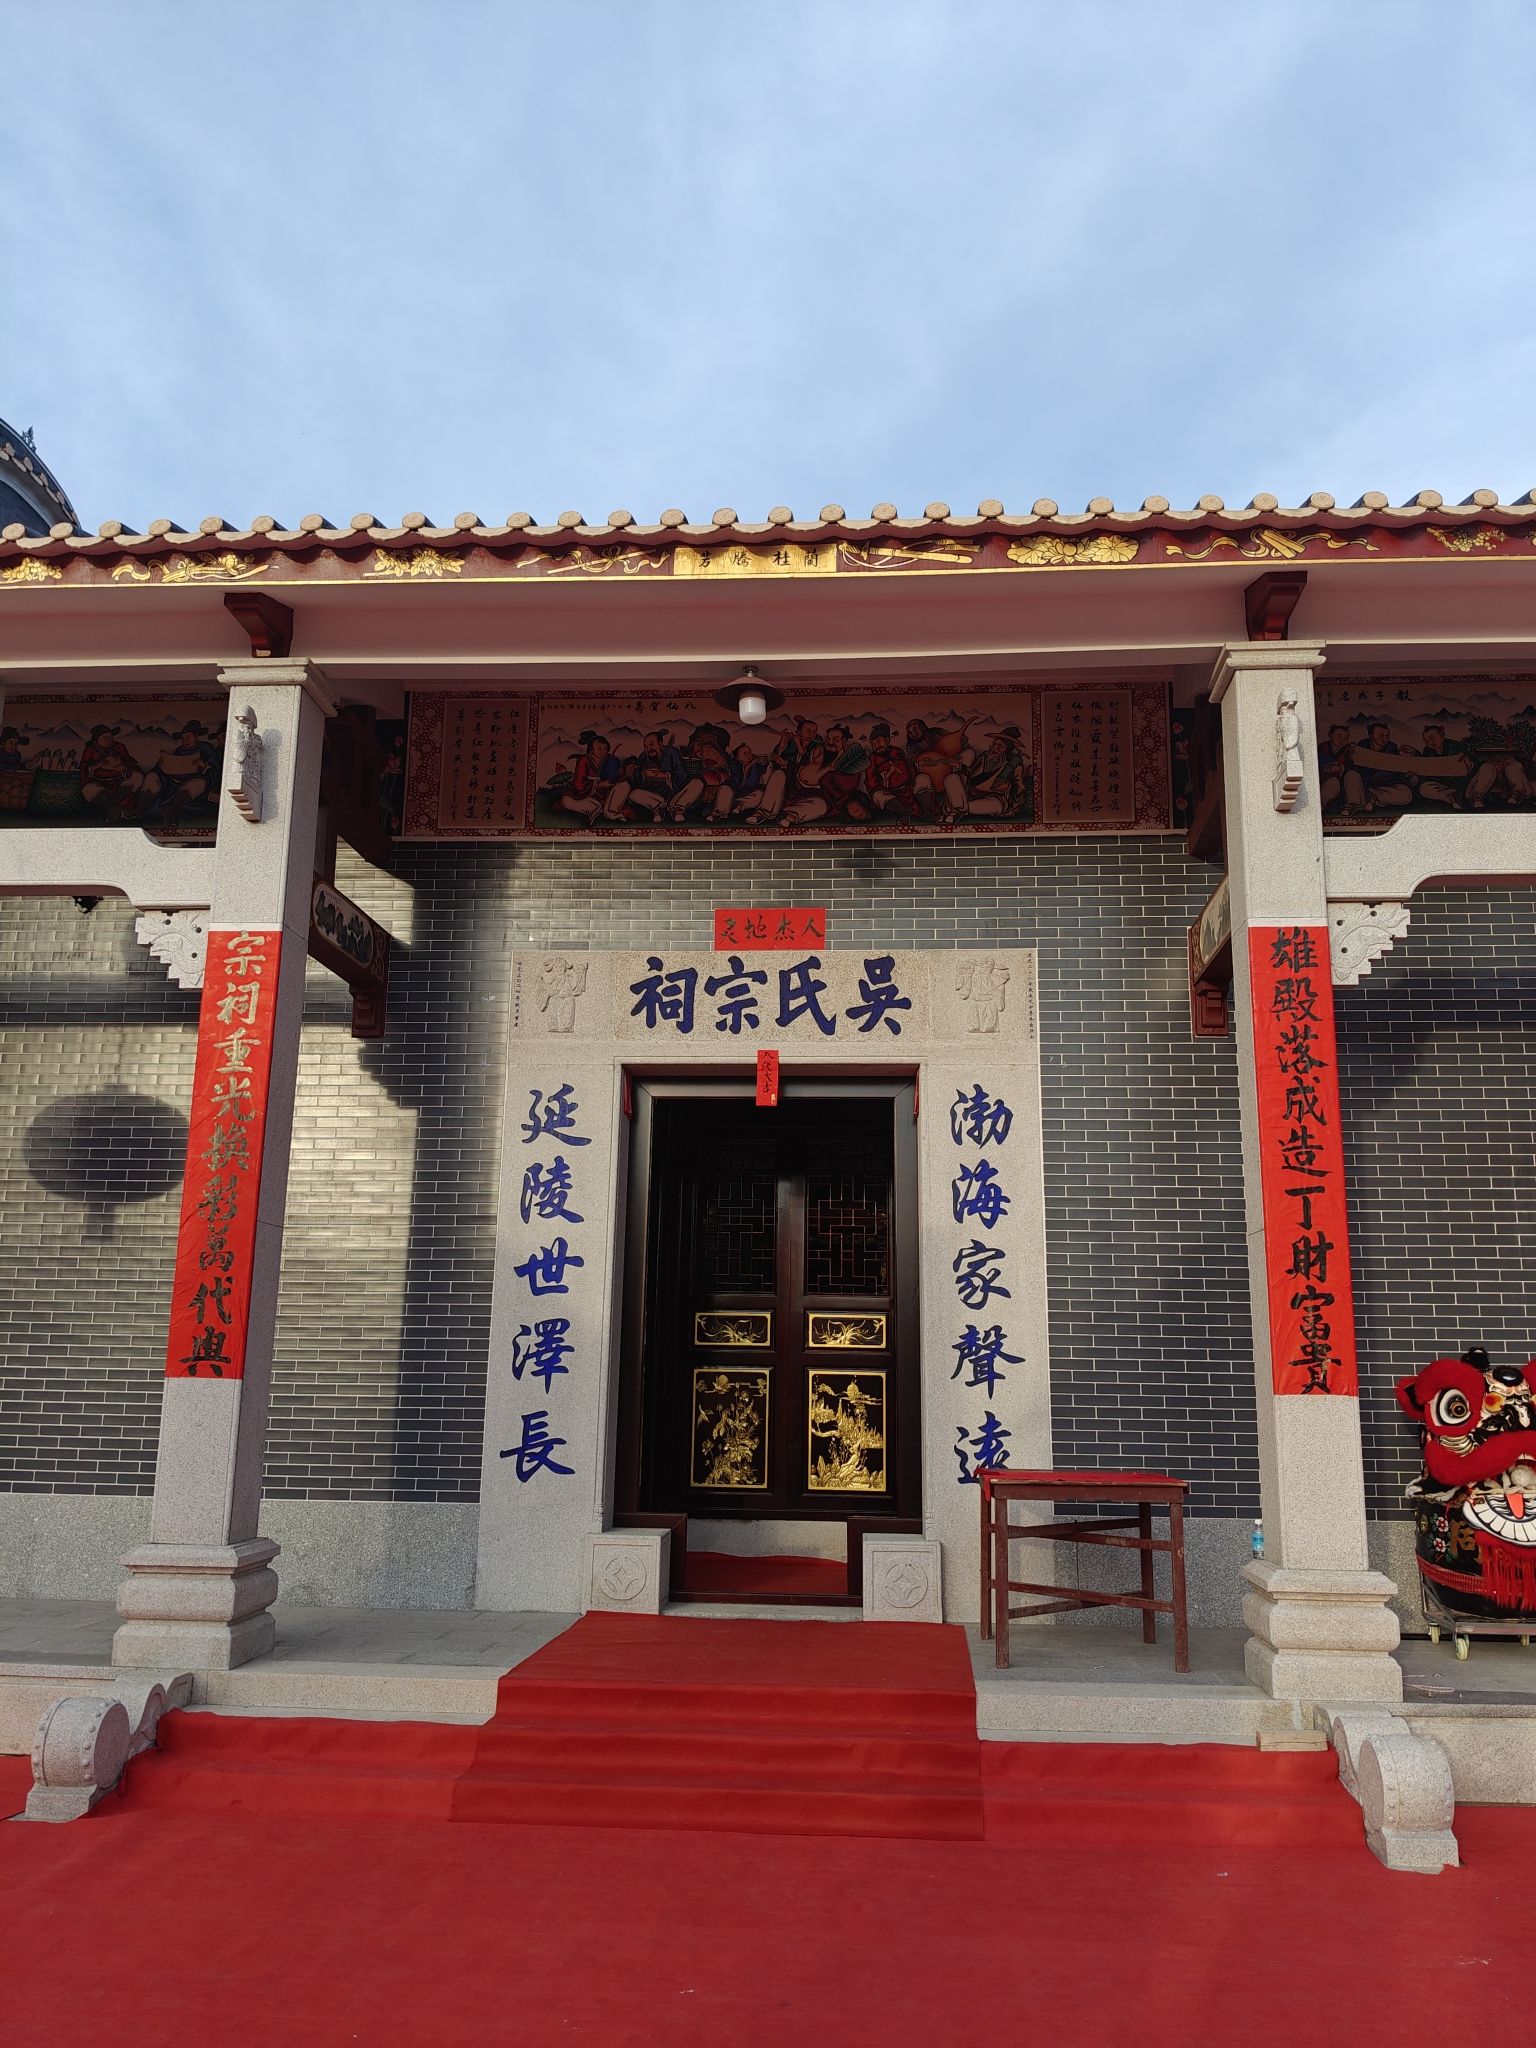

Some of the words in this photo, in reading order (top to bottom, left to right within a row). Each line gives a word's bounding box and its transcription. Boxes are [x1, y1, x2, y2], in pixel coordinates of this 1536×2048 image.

[698, 548, 819, 568] 蘭桂騰芳
[631, 956, 913, 1037] 吳氏宗祠
[719, 913, 824, 945] 人杰地灵
[1267, 926, 1343, 1395] 雄殿落成造丁財富貴
[500, 1083, 592, 1483] 延陵世澤長
[951, 1083, 1026, 1485] 渤海家聲遠
